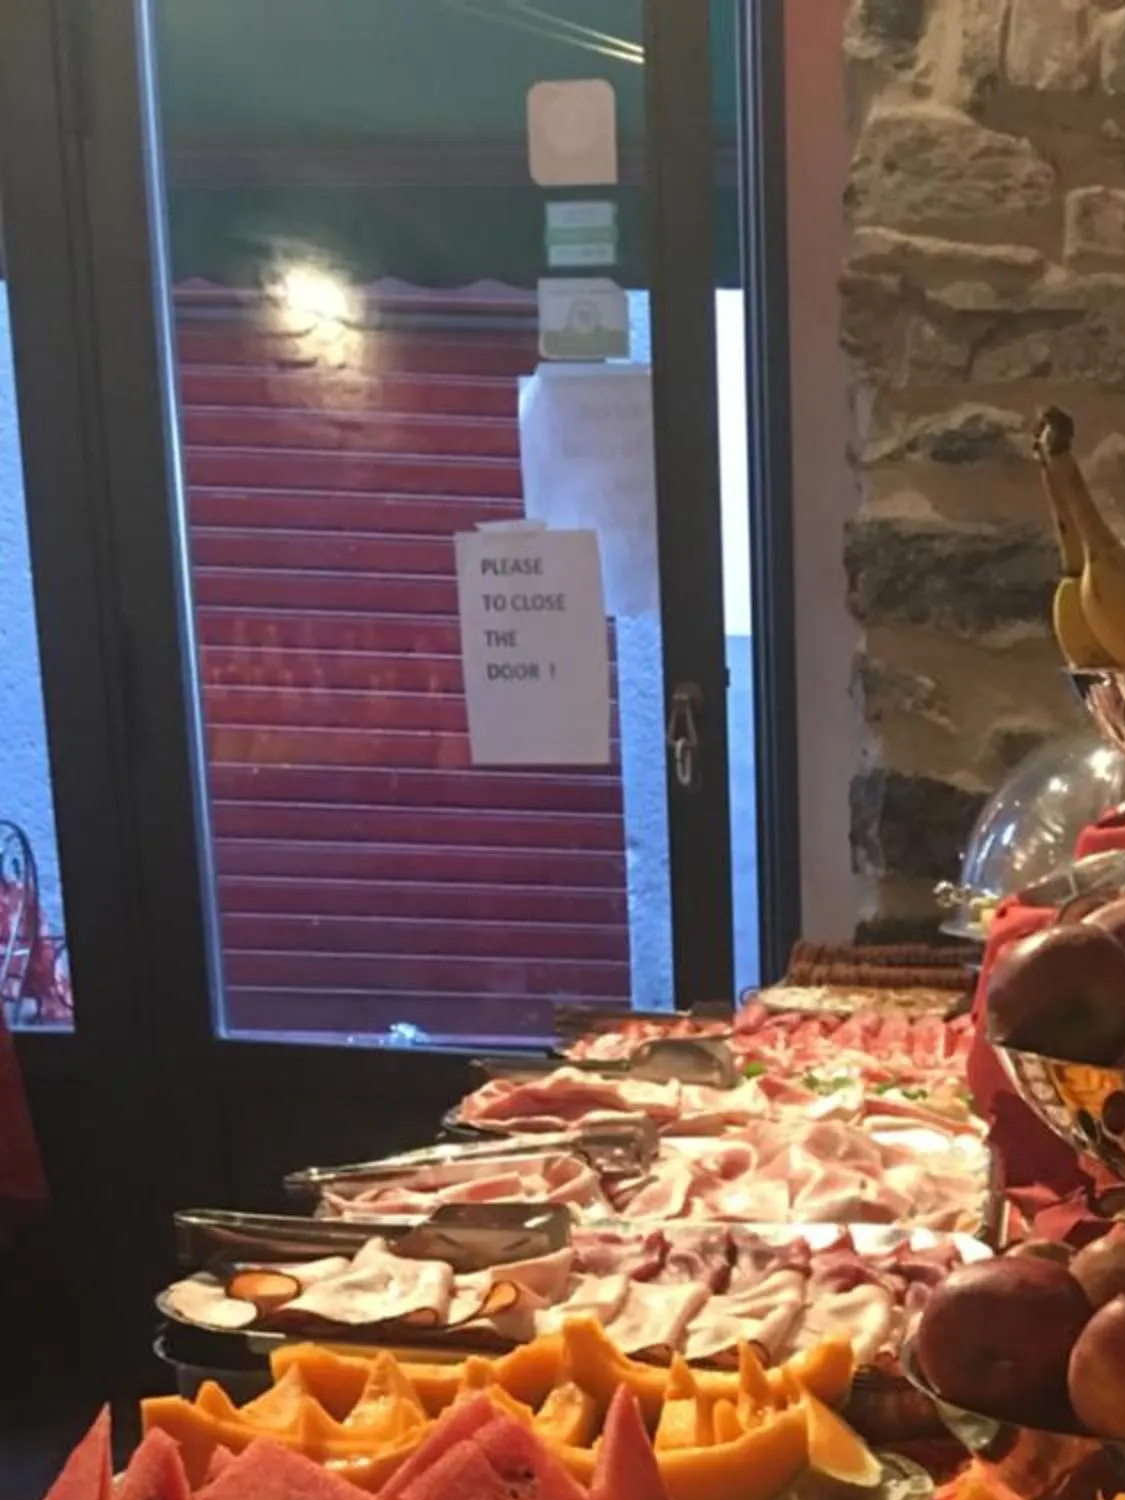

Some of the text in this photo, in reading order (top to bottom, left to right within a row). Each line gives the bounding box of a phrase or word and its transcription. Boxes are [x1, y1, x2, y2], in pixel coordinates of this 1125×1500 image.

[481, 558, 543, 575] PLEASE
[482, 594, 566, 612] TO CLOSE
[485, 630, 517, 647] THE
[486, 663, 540, 681] DOOR
